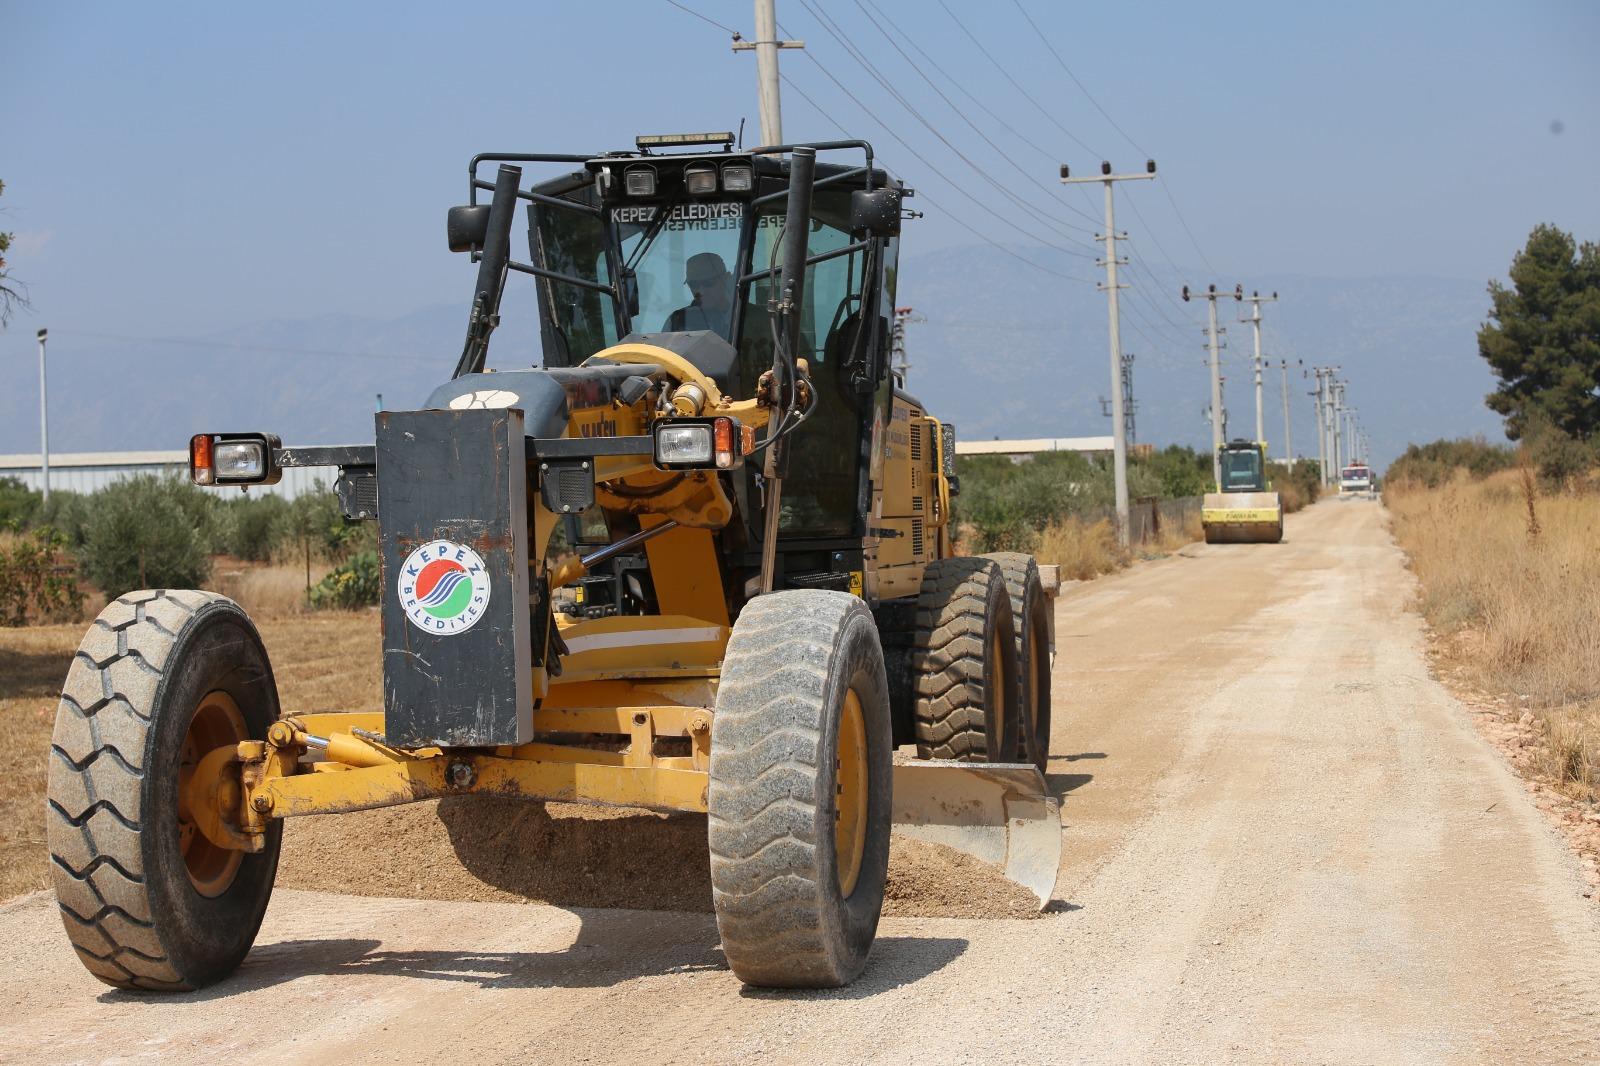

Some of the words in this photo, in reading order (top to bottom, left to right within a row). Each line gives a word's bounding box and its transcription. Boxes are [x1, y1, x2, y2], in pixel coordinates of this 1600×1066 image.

[611, 207, 657, 223] KEPEZ
[663, 202, 743, 220] ELEDiYESi
[406, 545, 481, 577] KEPEZ
